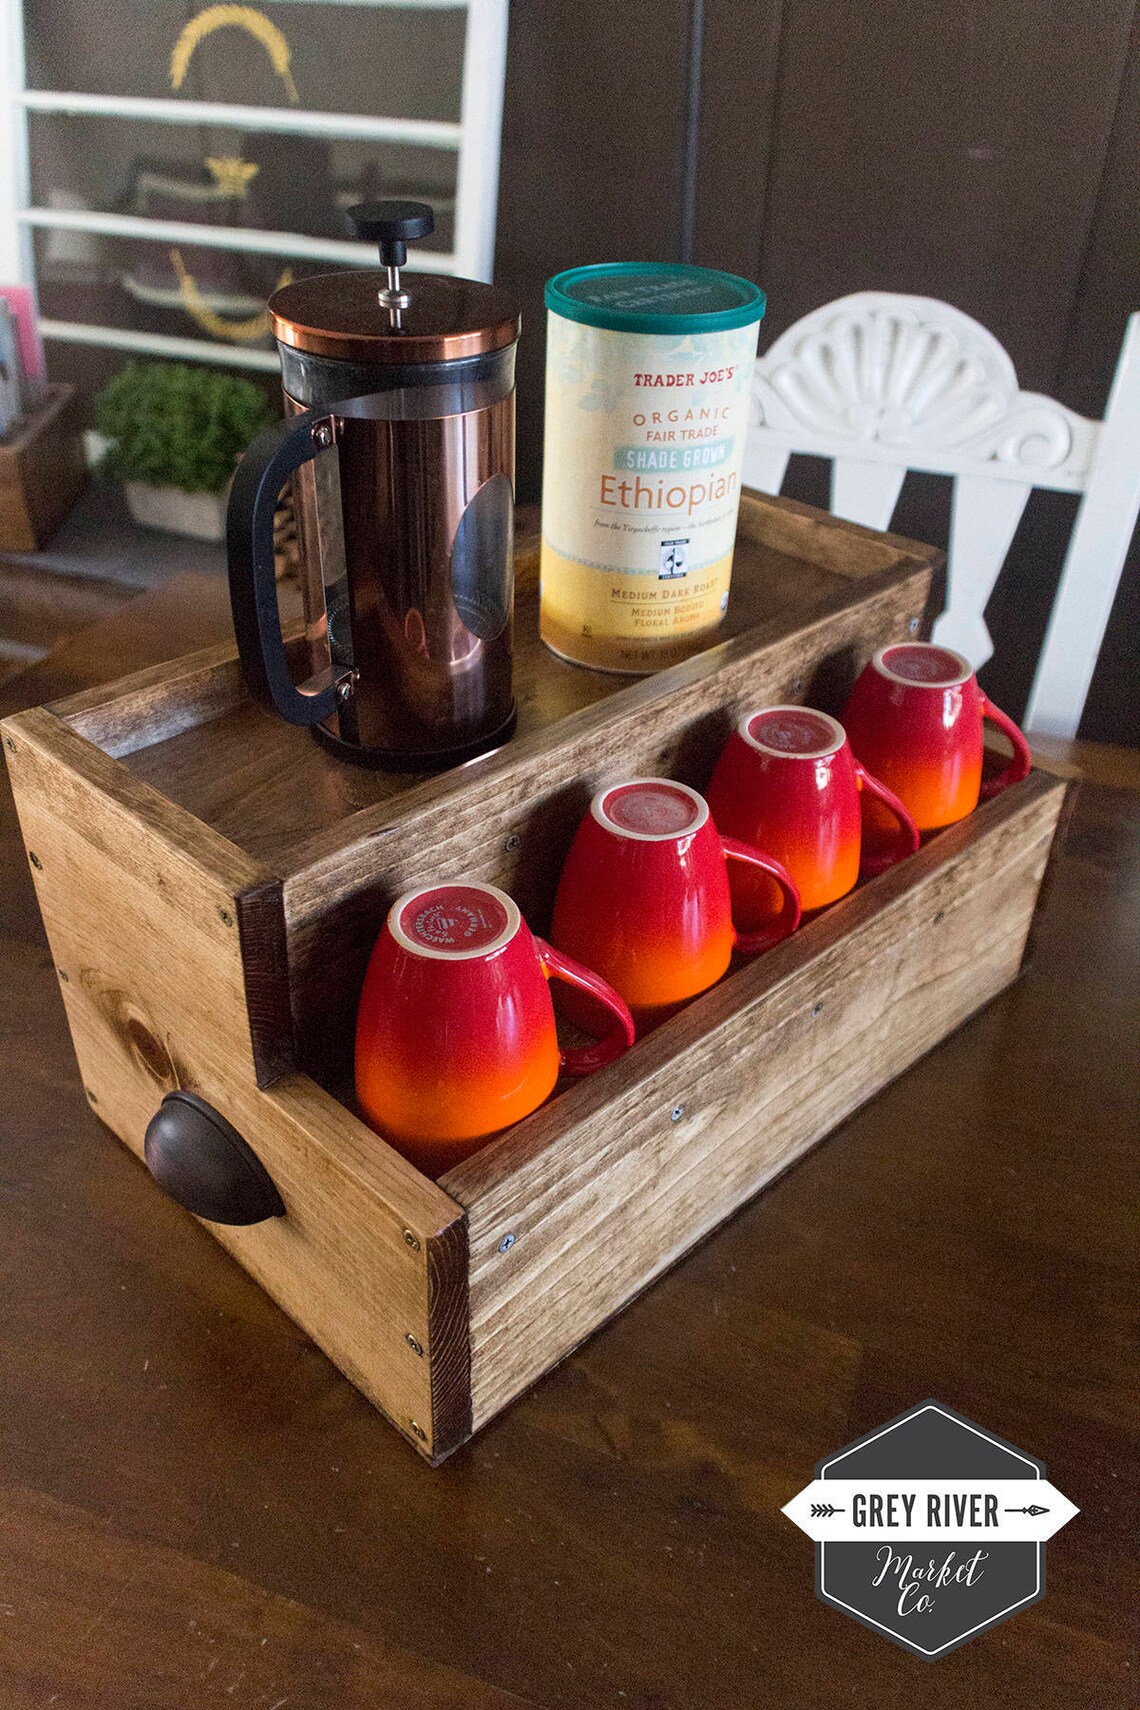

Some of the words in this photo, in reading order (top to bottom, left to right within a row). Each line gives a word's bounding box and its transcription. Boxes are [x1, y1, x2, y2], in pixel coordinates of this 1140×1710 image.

[633, 373, 694, 387] TRADER
[700, 367, 735, 384] JOE'S
[632, 407, 730, 426] ORGANIC
[646, 430, 676, 441] FAIR
[680, 425, 719, 441] TRADE
[626, 450, 677, 469] SHADE
[682, 444, 726, 468] GROWN
[600, 471, 737, 516] Ethiopian
[610, 522, 621, 531] the
[611, 588, 657, 600] MEDIUM
[662, 588, 690, 599] DARK
[693, 578, 719, 594] ROAST
[631, 607, 671, 617] MEDIUM
[635, 618, 669, 628] FLORAL
